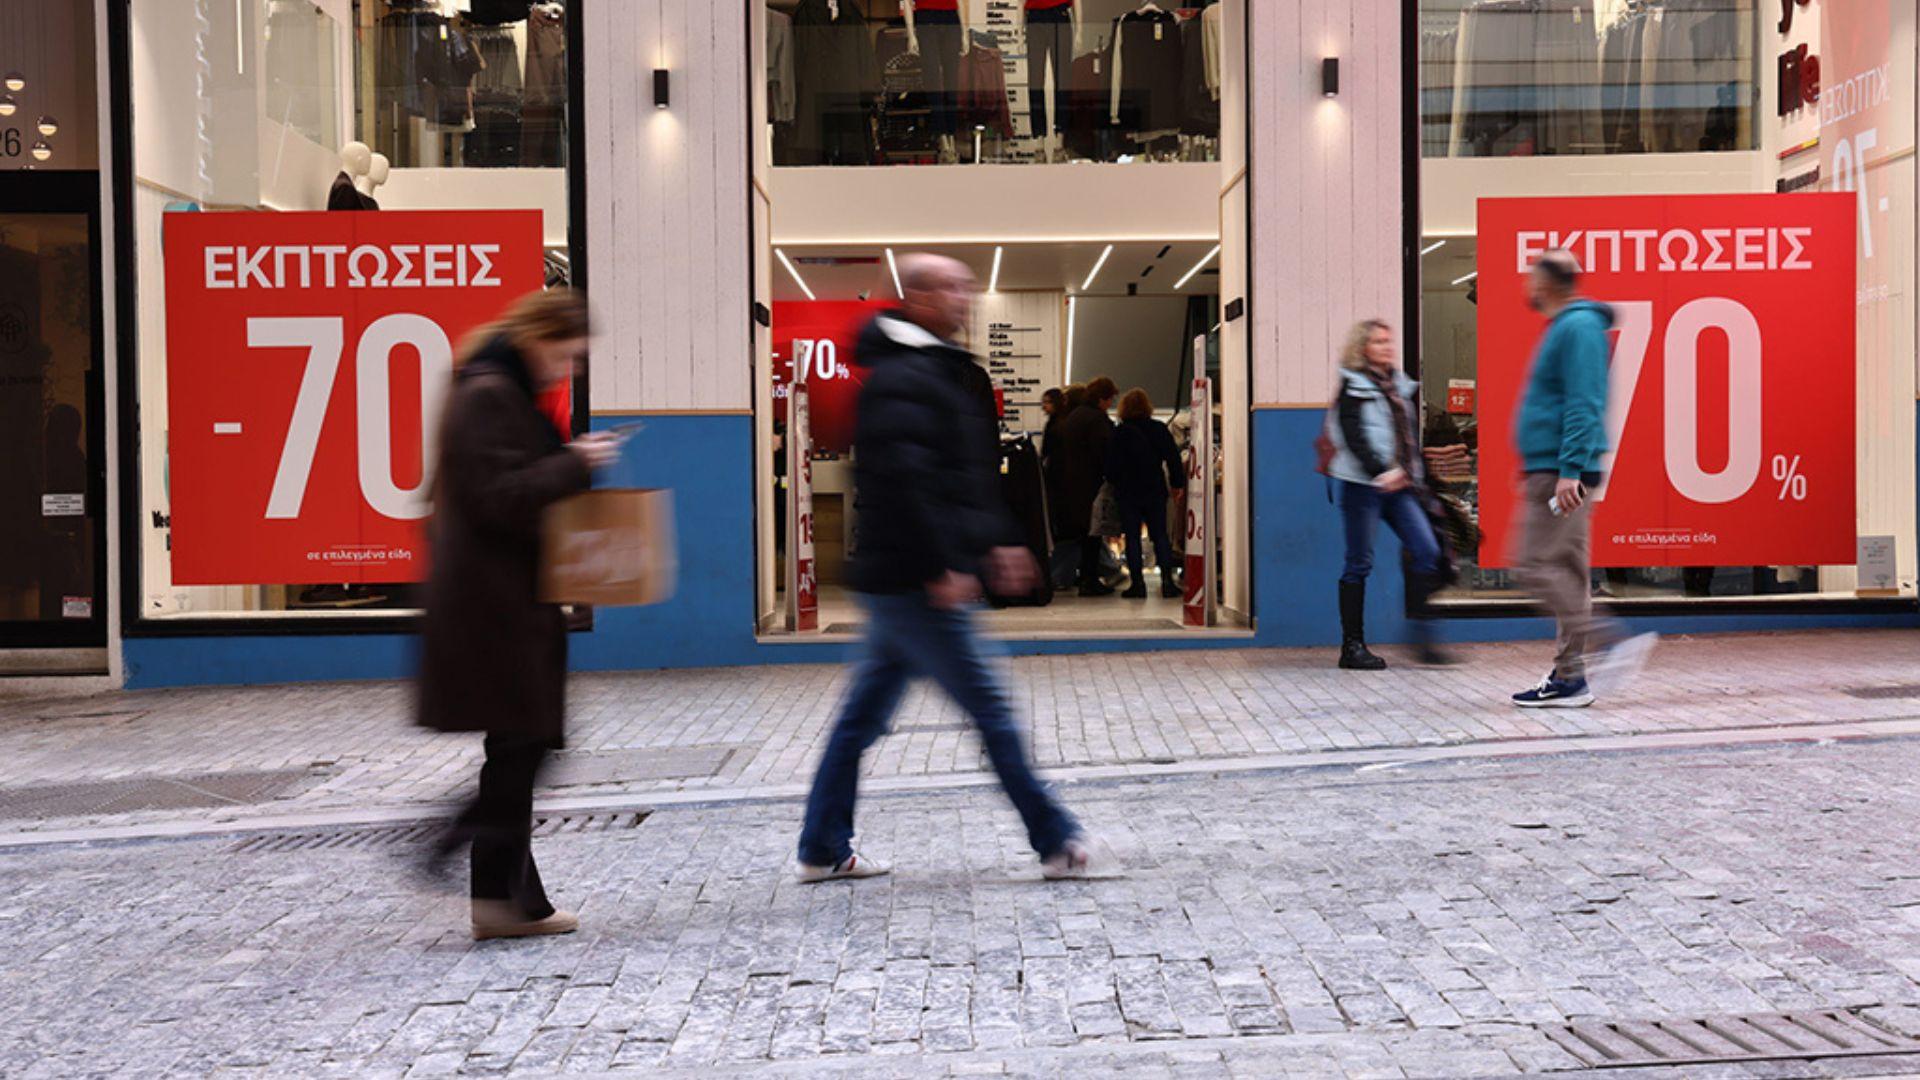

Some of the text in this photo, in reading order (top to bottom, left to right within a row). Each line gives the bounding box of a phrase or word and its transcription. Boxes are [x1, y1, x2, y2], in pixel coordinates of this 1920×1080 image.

[0, 128, 21, 157] 6
[1516, 227, 1813, 273] ΕΚΠΤΩΣΕΙΣ
[204, 244, 502, 289] ΕΚΠΤΩΣΕΙΣ
[1612, 532, 1717, 545] σε επιλεγμένα είδη
[306, 548, 412, 562] σε επιλεγμένα είδη
